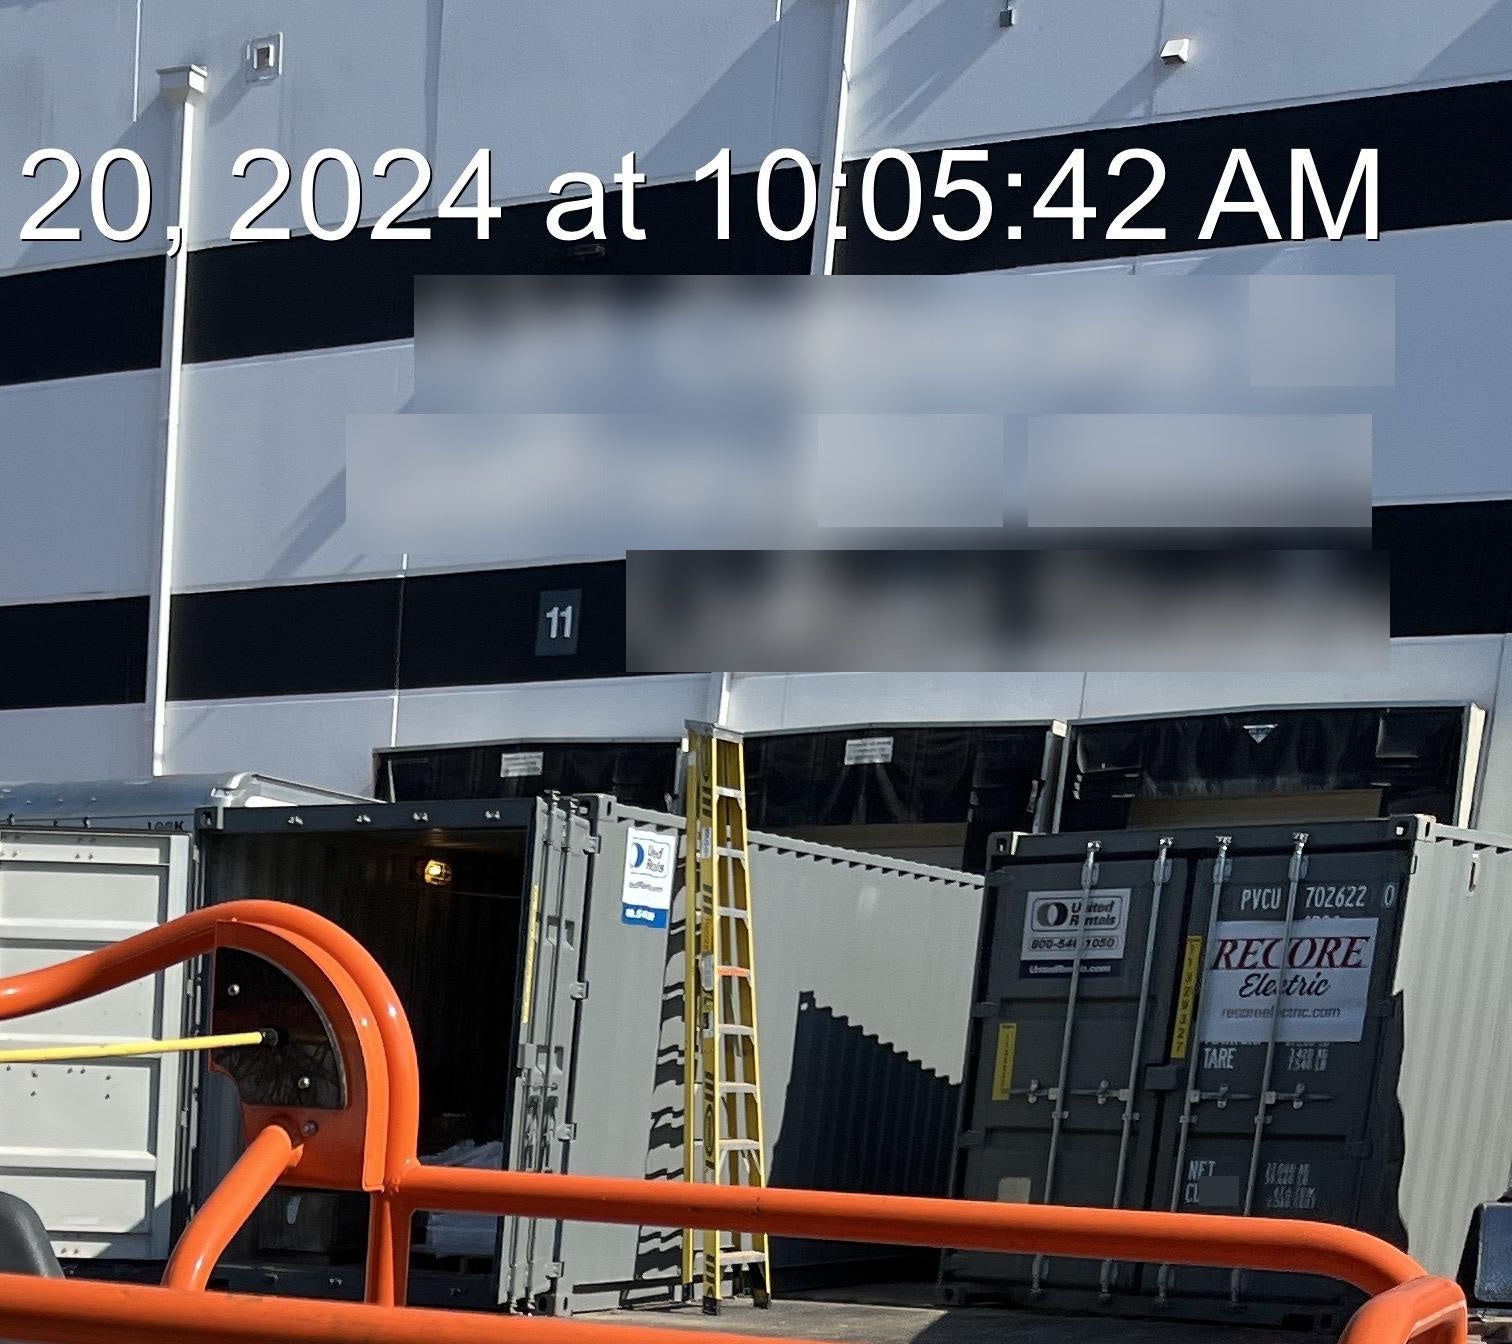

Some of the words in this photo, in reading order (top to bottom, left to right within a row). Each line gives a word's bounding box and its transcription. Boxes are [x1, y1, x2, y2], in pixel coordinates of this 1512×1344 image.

[545, 605, 573, 639] 11
[1070, 900, 1115, 914] Uited
[1240, 887, 1282, 910] PVCU
[1305, 884, 1368, 908] 702622
[1212, 936, 1371, 970] RECORE
[1222, 1004, 1341, 1019] recoreelctric.com
[1204, 1048, 1237, 1069] TARE
